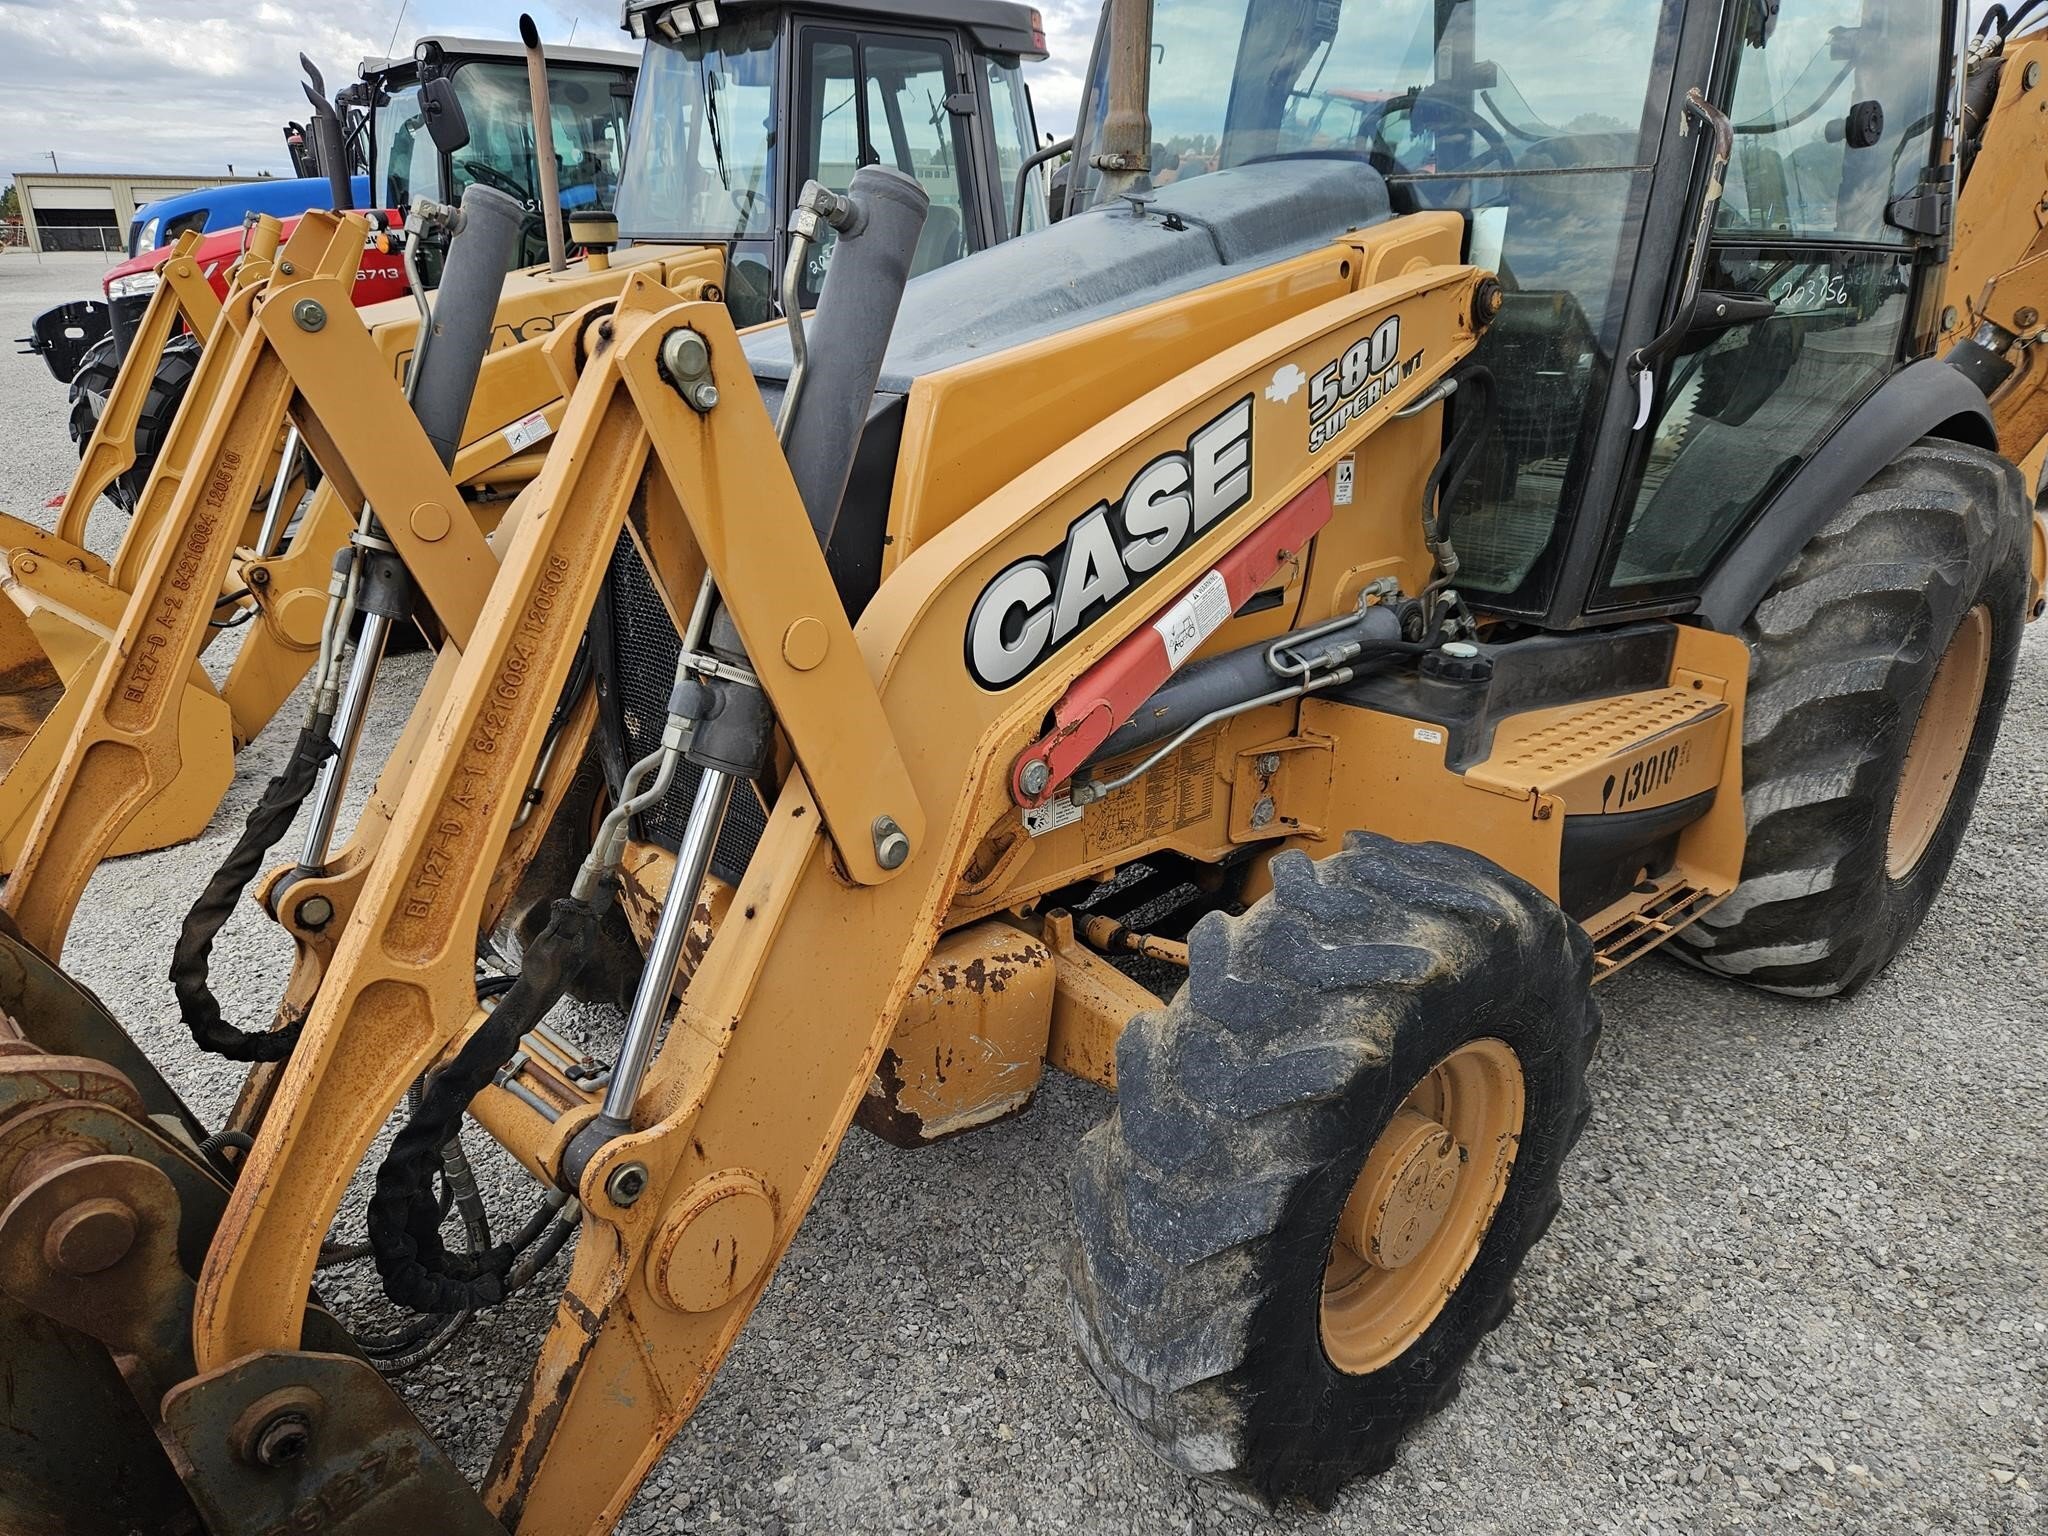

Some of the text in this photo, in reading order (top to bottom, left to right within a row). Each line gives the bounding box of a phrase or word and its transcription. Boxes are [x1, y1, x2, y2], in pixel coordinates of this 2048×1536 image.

[356, 268, 399, 281] 6713
[1780, 274, 1847, 305] 203756
[1308, 314, 1400, 427] 580
[1308, 348, 1425, 454] SUPER N WT
[124, 450, 241, 703] BLT27-D A-2 84216094 120510
[963, 391, 1255, 692] CASE
[405, 819, 463, 919] BLT27-D
[452, 765, 487, 809] A-1
